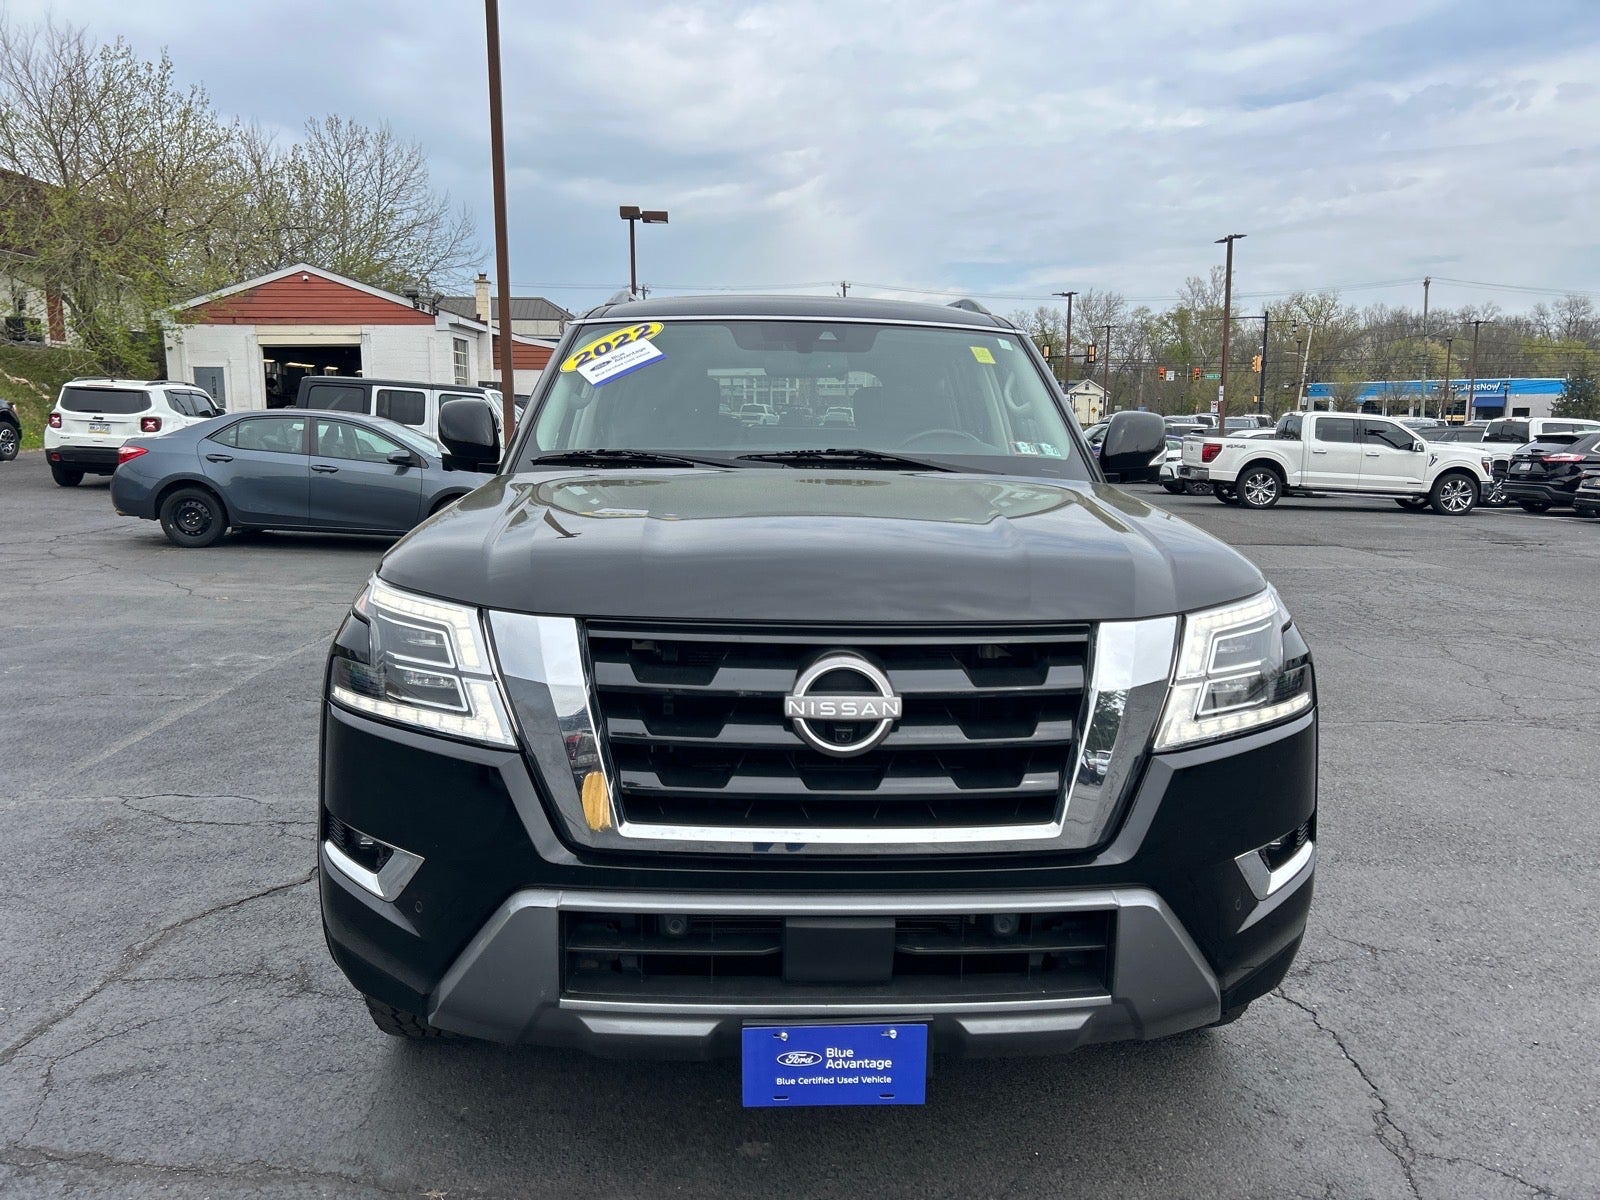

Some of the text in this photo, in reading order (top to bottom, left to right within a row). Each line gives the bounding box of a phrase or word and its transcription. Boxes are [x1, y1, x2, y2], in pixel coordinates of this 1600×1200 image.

[574, 325, 654, 367] 2022
[788, 701, 899, 716] NISSAN
[825, 1047, 854, 1058] Blue
[785, 1053, 815, 1064] Ford
[825, 1058, 893, 1070] Advantage
[776, 1075, 892, 1085] Blue Certified Used Vehicle
